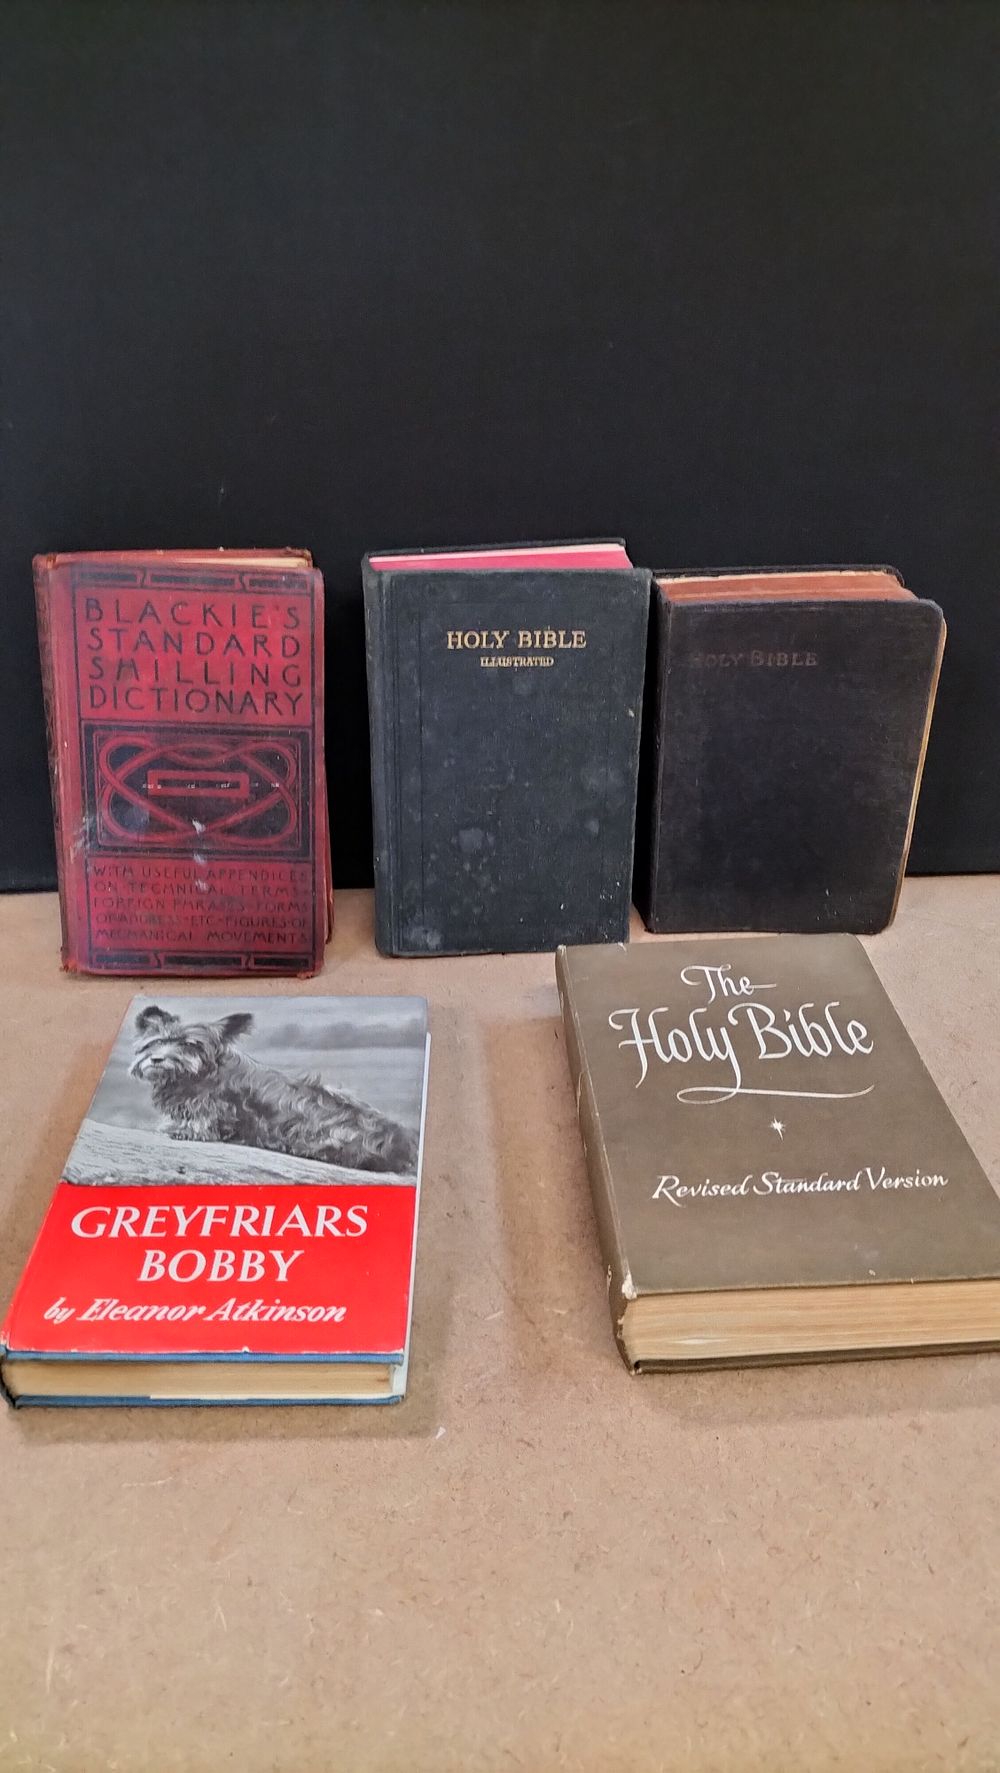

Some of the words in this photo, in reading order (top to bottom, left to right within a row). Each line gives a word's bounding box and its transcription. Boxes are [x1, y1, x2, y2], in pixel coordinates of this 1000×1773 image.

[85, 598, 300, 630] BLACKIE'S
[87, 627, 300, 658] STANDARD
[446, 630, 510, 650] HOLY
[517, 630, 587, 649] BIBLE
[88, 656, 300, 688] SHILLING
[480, 656, 554, 668] ILLUSTRATED
[750, 649, 818, 666] BIBLE
[89, 685, 303, 716] DICTIONARY
[94, 865, 134, 877] WITH
[142, 866, 202, 880] USEFUL
[680, 964, 777, 1004] The
[608, 1006, 743, 1093] Holy
[727, 1001, 875, 1060] Bible
[651, 1174, 753, 1208] Revised
[752, 1170, 862, 1196] Standard
[862, 1166, 949, 1191] Version
[70, 1204, 369, 1239] GREYFRIARS
[136, 1249, 305, 1283] BOBBY
[43, 1297, 76, 1325] by
[76, 1298, 206, 1323] Eleanor
[203, 1297, 348, 1323] Atkinson
